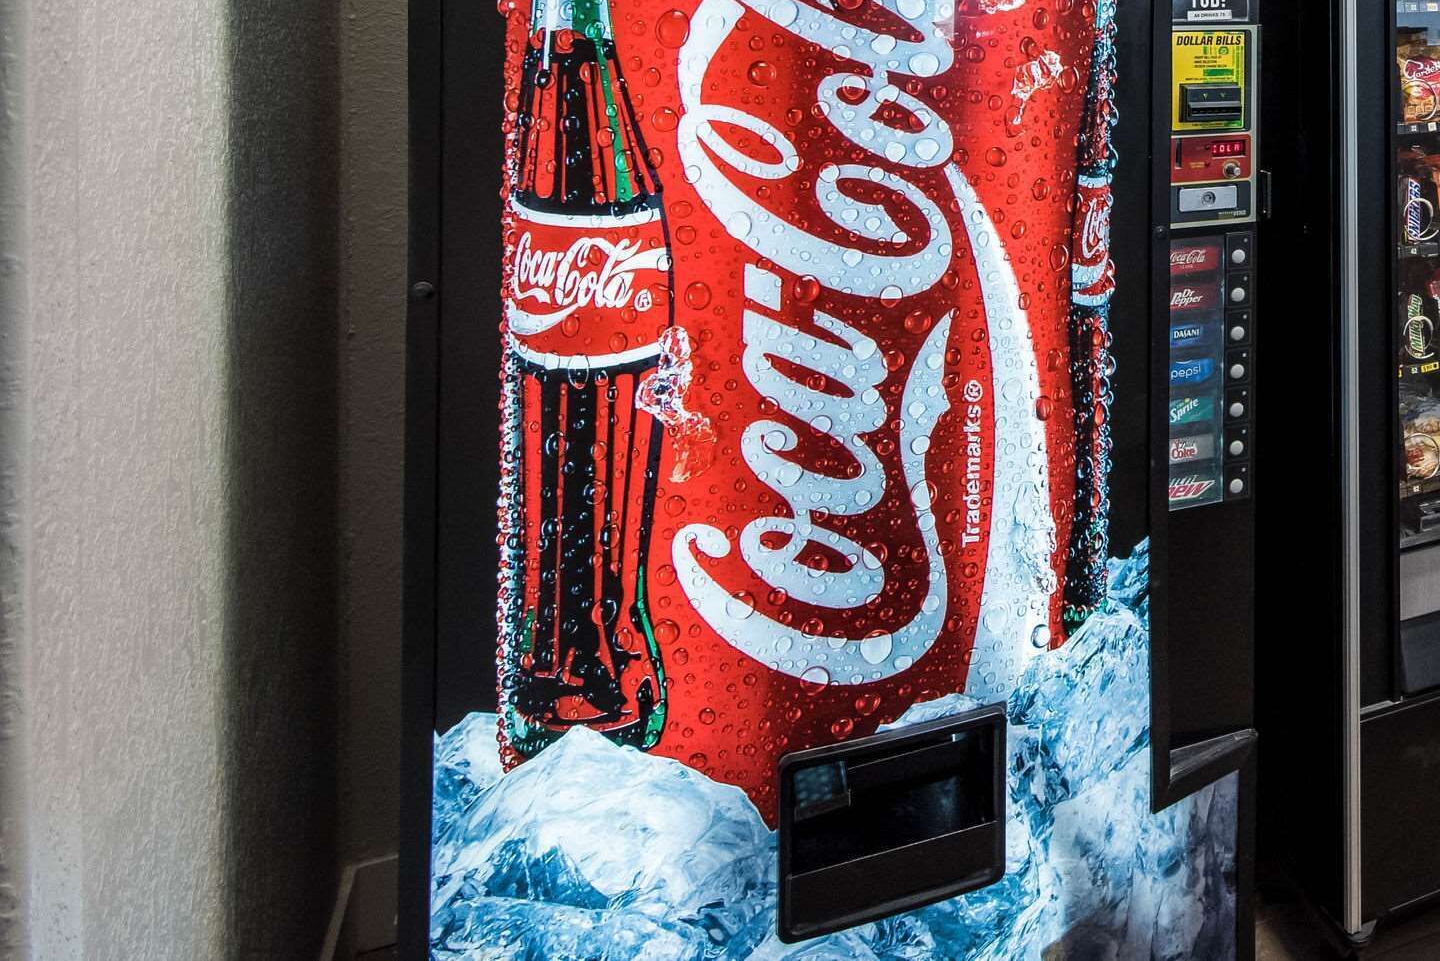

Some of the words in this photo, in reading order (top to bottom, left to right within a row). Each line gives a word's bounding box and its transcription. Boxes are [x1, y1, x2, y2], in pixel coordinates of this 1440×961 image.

[1176, 36, 1213, 46] DOLLAR
[1216, 35, 1242, 46] BILLS
[1170, 249, 1206, 264] Coca-Cola
[513, 231, 642, 309] Coca-Cola
[1170, 292, 1204, 307] Pepper
[1182, 288, 1195, 298] Dr
[1174, 328, 1200, 338] DASANI
[1170, 363, 1201, 380] pepsi
[1170, 398, 1199, 423] Sprite
[1172, 447, 1196, 459] Coke
